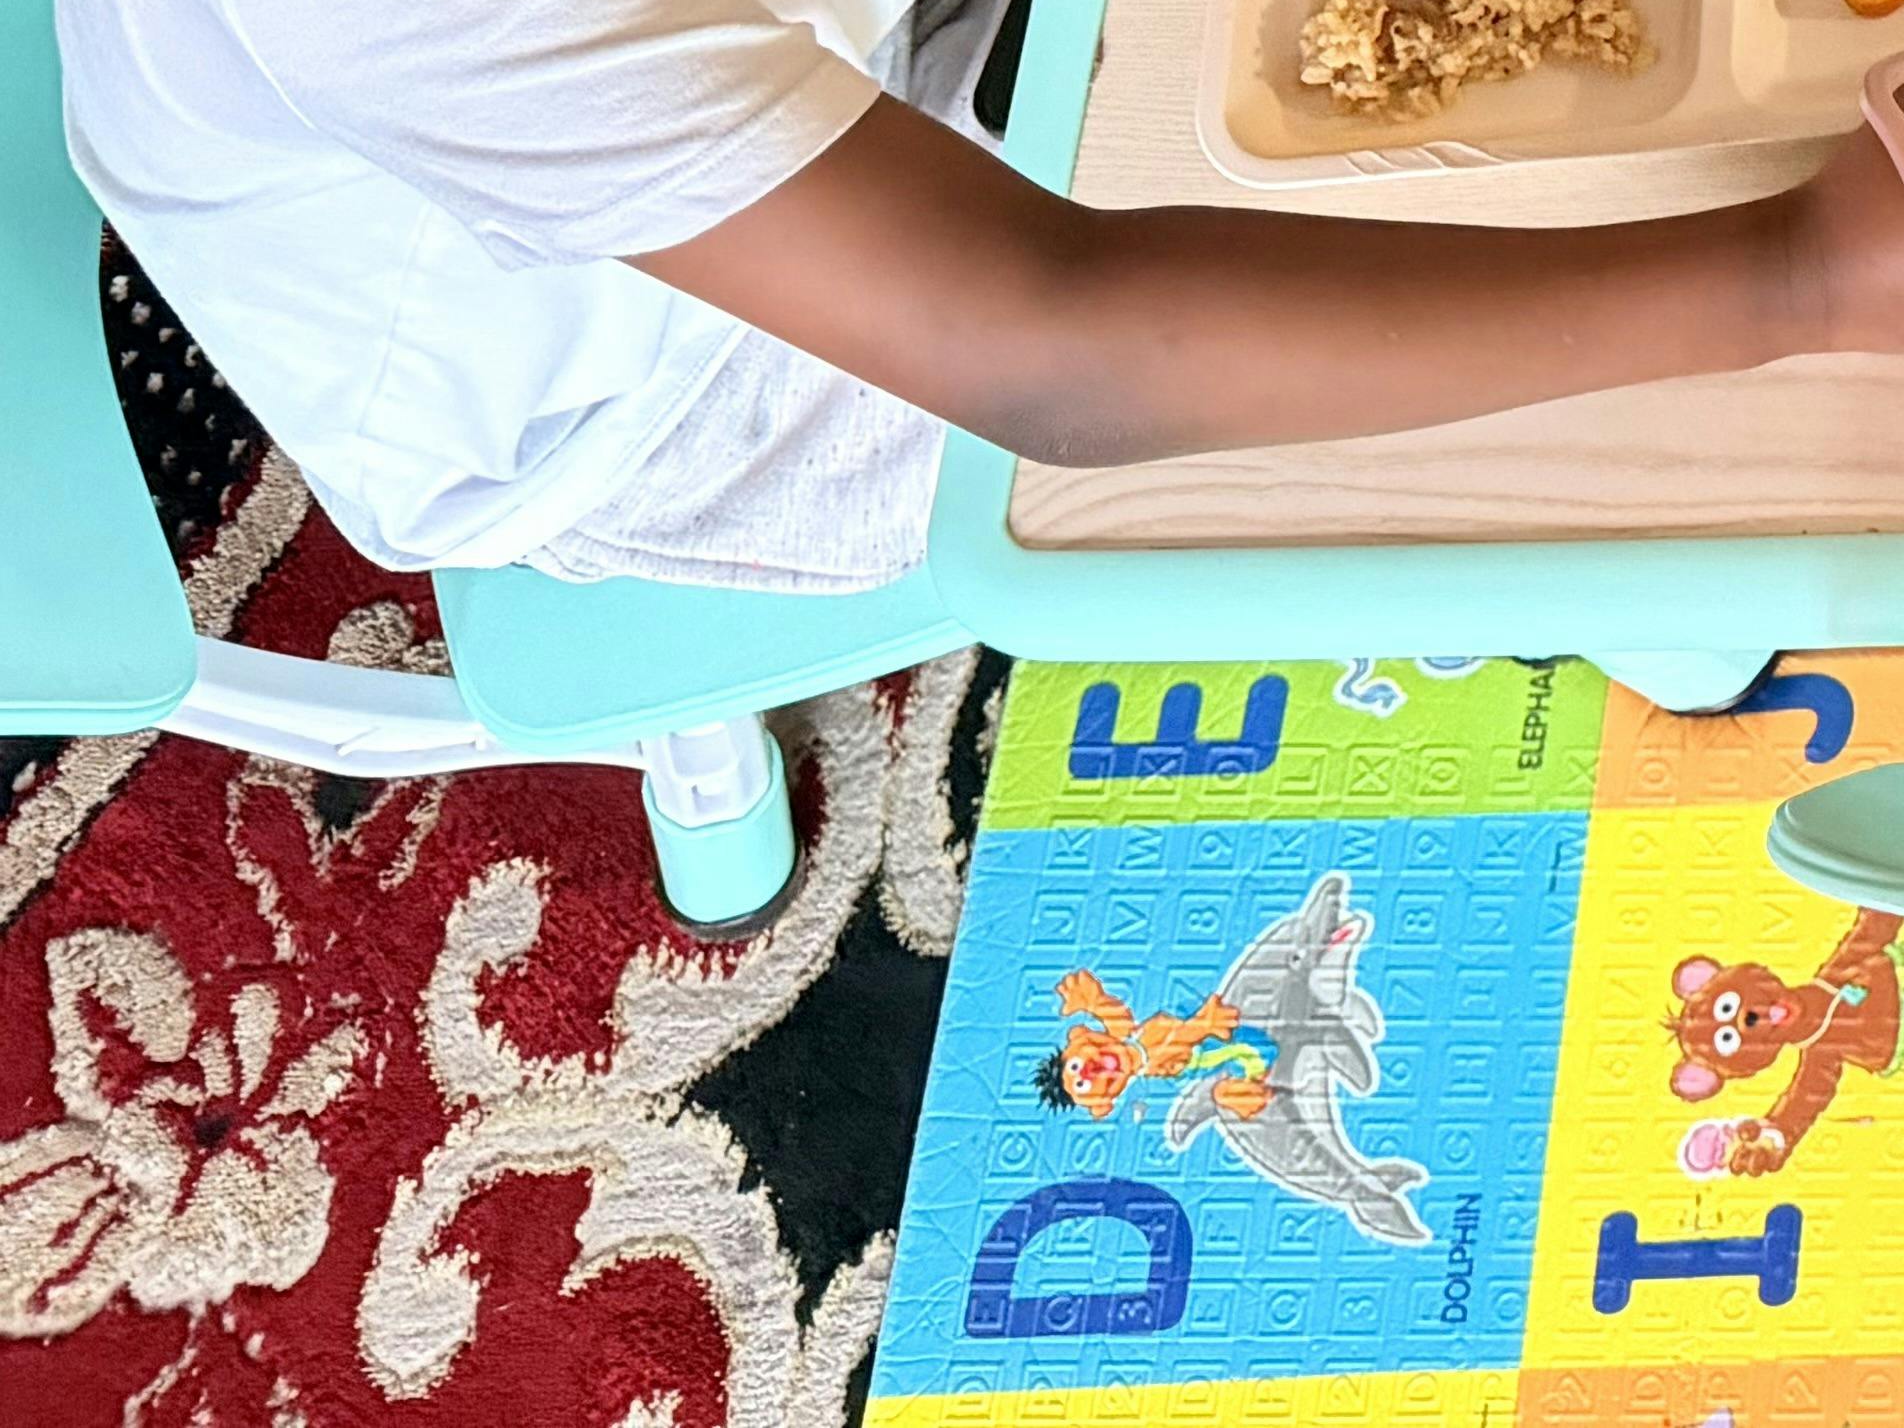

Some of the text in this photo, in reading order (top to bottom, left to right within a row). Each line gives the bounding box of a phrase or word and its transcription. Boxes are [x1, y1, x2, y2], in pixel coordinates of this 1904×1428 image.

[1069, 675, 1289, 779] E
[963, 1175, 1195, 1339] D
[1441, 1192, 1482, 1324] DOLPHIN
